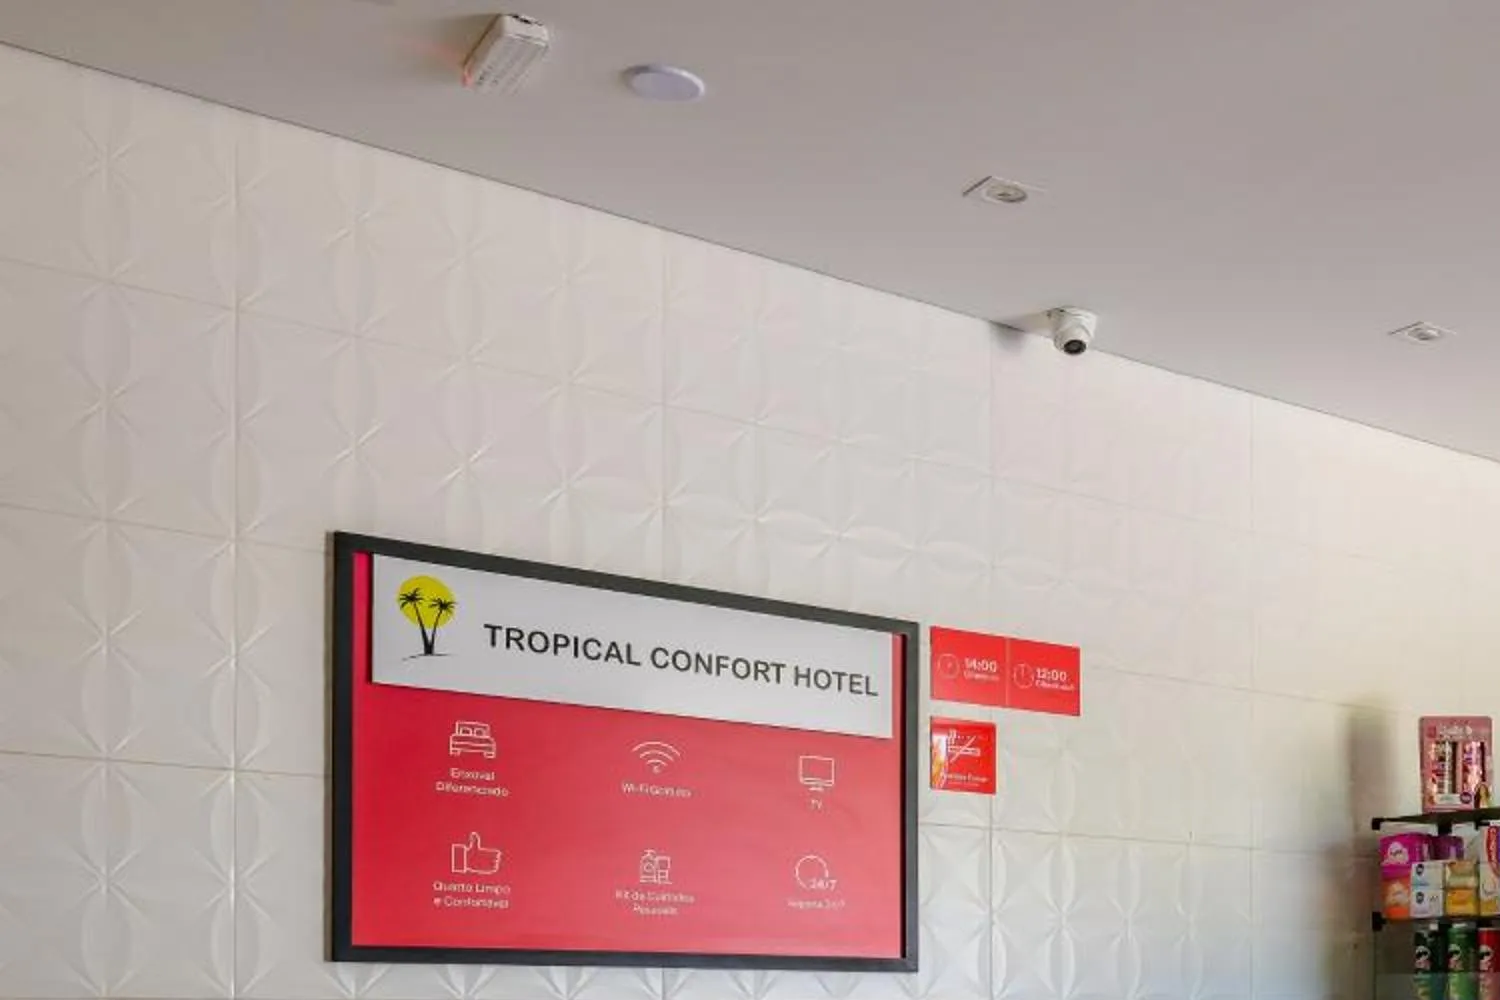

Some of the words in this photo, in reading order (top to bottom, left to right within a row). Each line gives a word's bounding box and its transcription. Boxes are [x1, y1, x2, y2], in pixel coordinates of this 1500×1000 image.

[484, 623, 641, 667] TROPICAL
[650, 646, 786, 685] CONFORT
[793, 665, 879, 698] HOTEL
